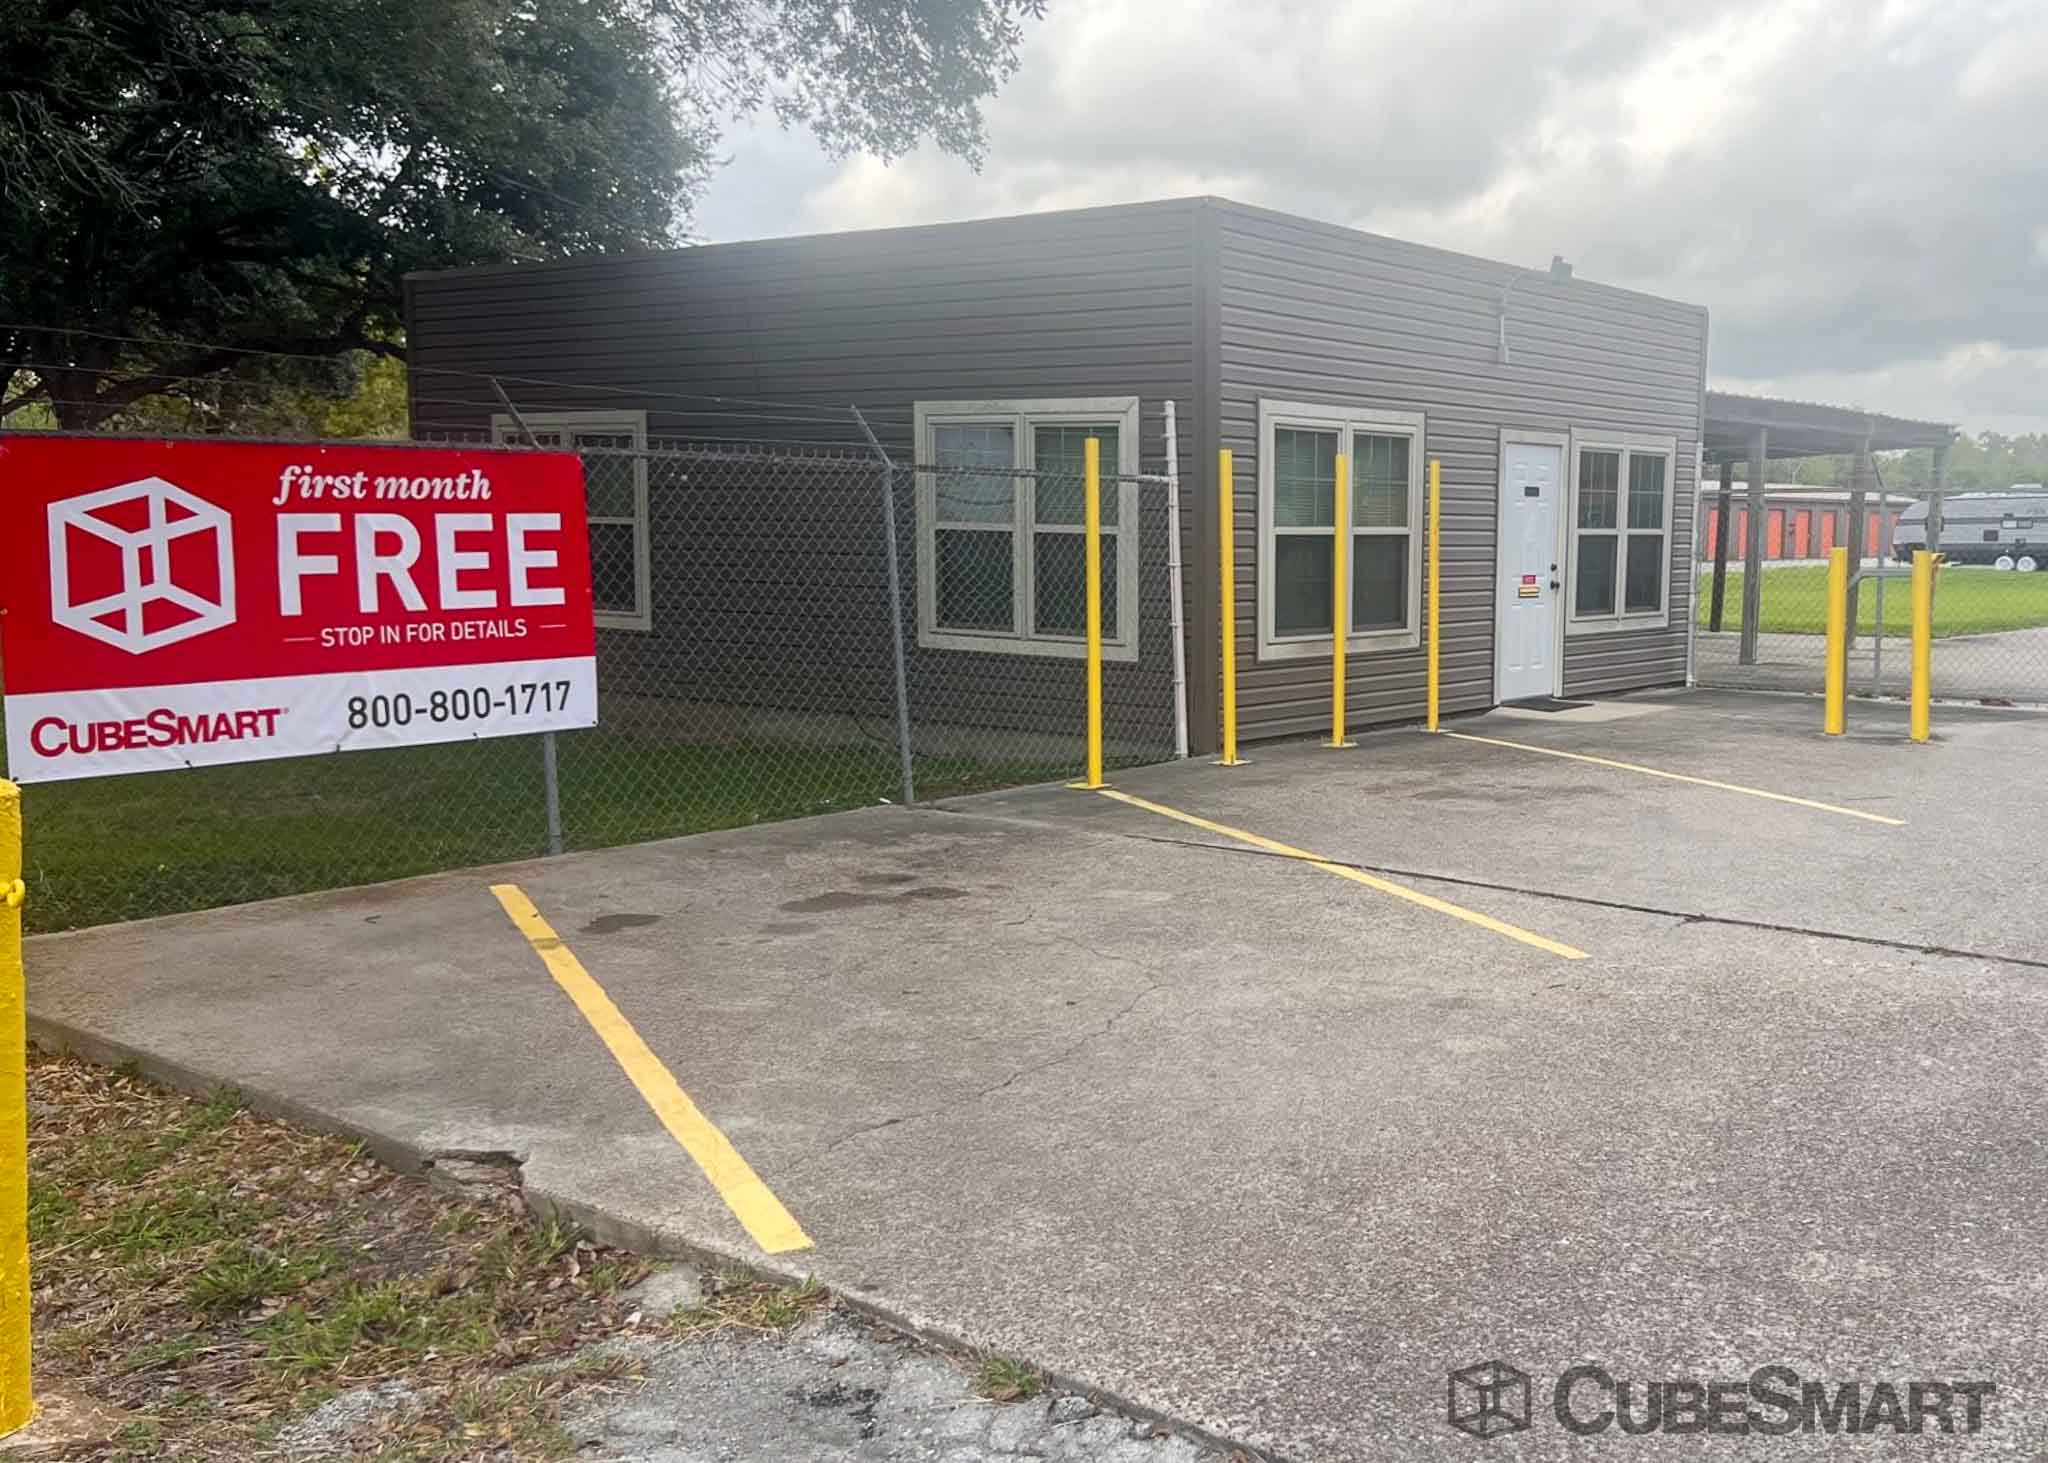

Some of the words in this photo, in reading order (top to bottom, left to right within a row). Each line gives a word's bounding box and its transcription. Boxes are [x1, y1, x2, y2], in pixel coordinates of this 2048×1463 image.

[273, 466, 367, 505] first
[375, 469, 492, 501] month
[276, 512, 566, 617] FREE
[321, 627, 374, 648] STOP
[380, 625, 401, 643] IN
[406, 623, 446, 643] FOR
[451, 619, 528, 641] DETAILS
[347, 680, 572, 729] 800-800-1717
